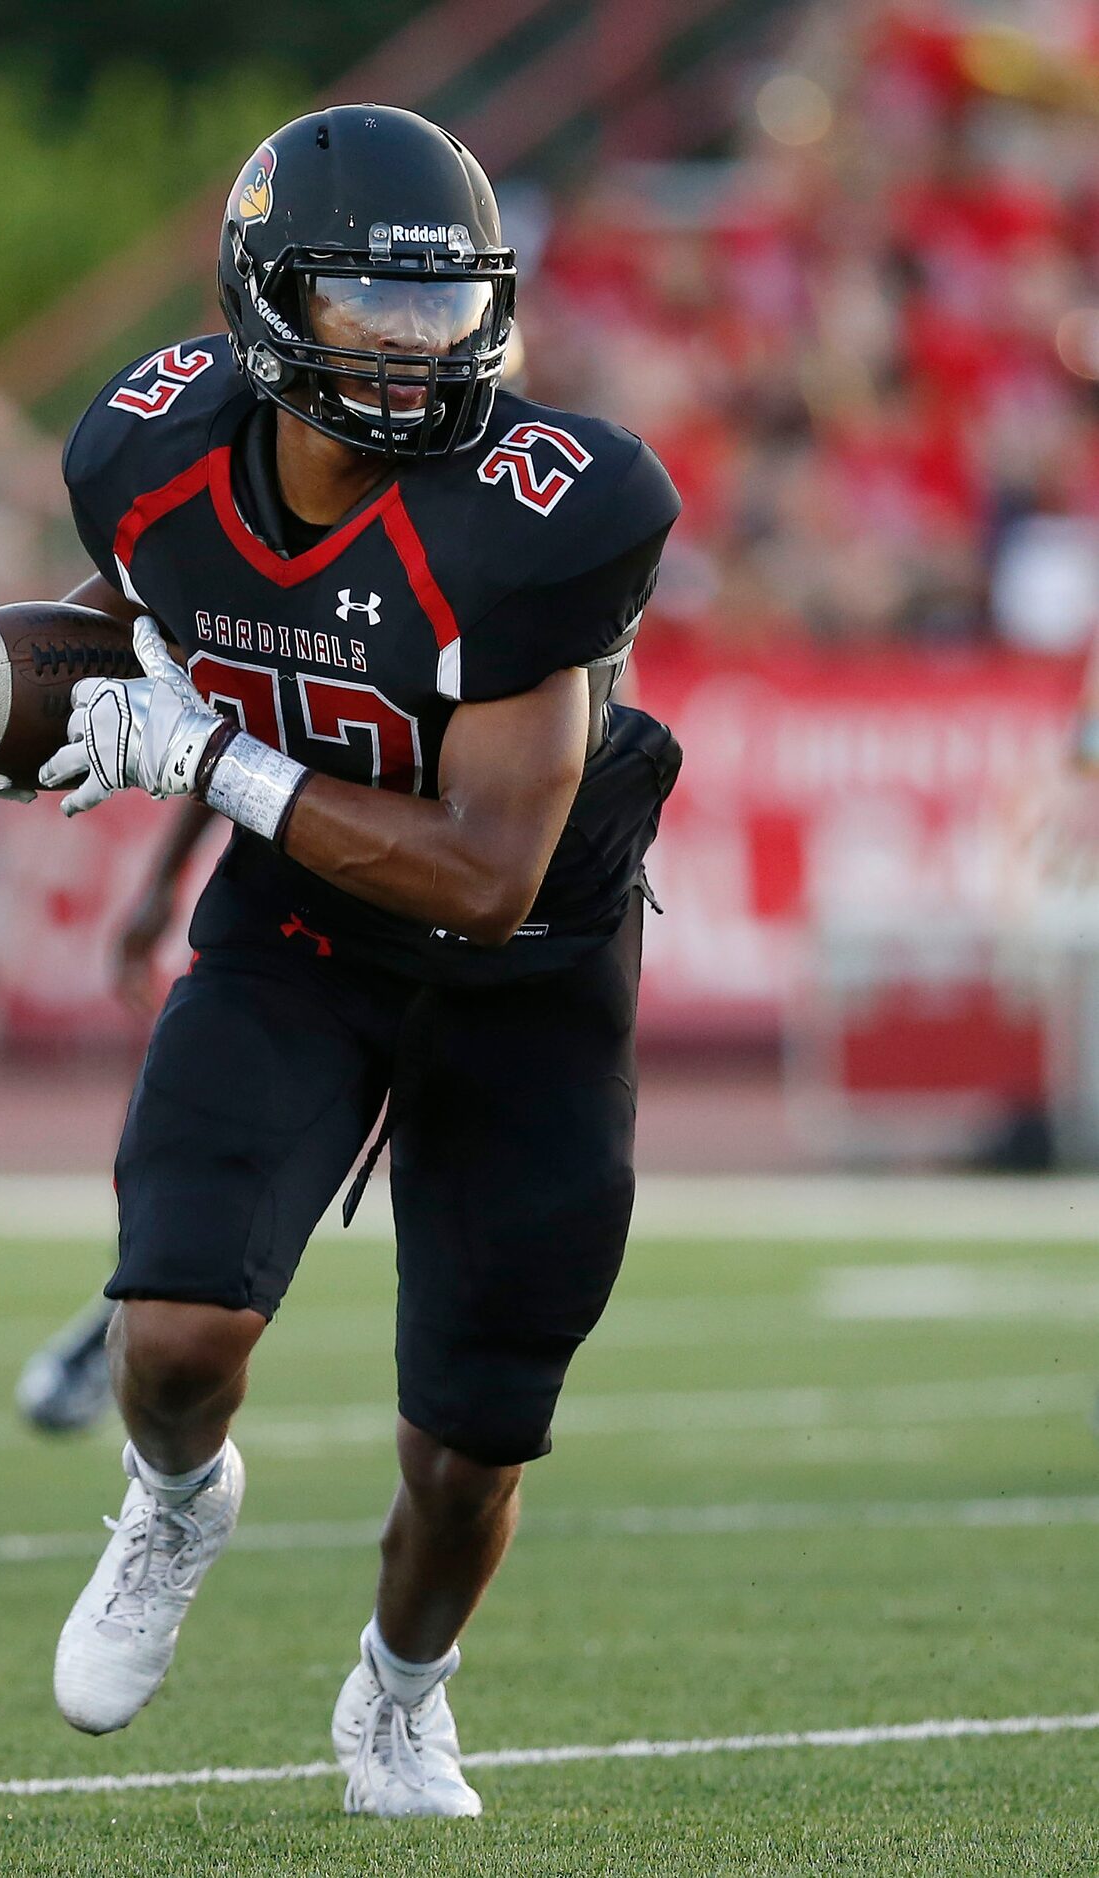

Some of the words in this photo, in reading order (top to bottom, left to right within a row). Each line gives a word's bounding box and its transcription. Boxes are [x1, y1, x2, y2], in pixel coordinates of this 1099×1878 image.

[392, 225, 447, 243] Riddell
[255, 296, 300, 341] Ridde
[107, 344, 215, 420] 27
[371, 429, 409, 441] Riell
[477, 421, 594, 518] 27
[195, 609, 368, 673] CARDINALS
